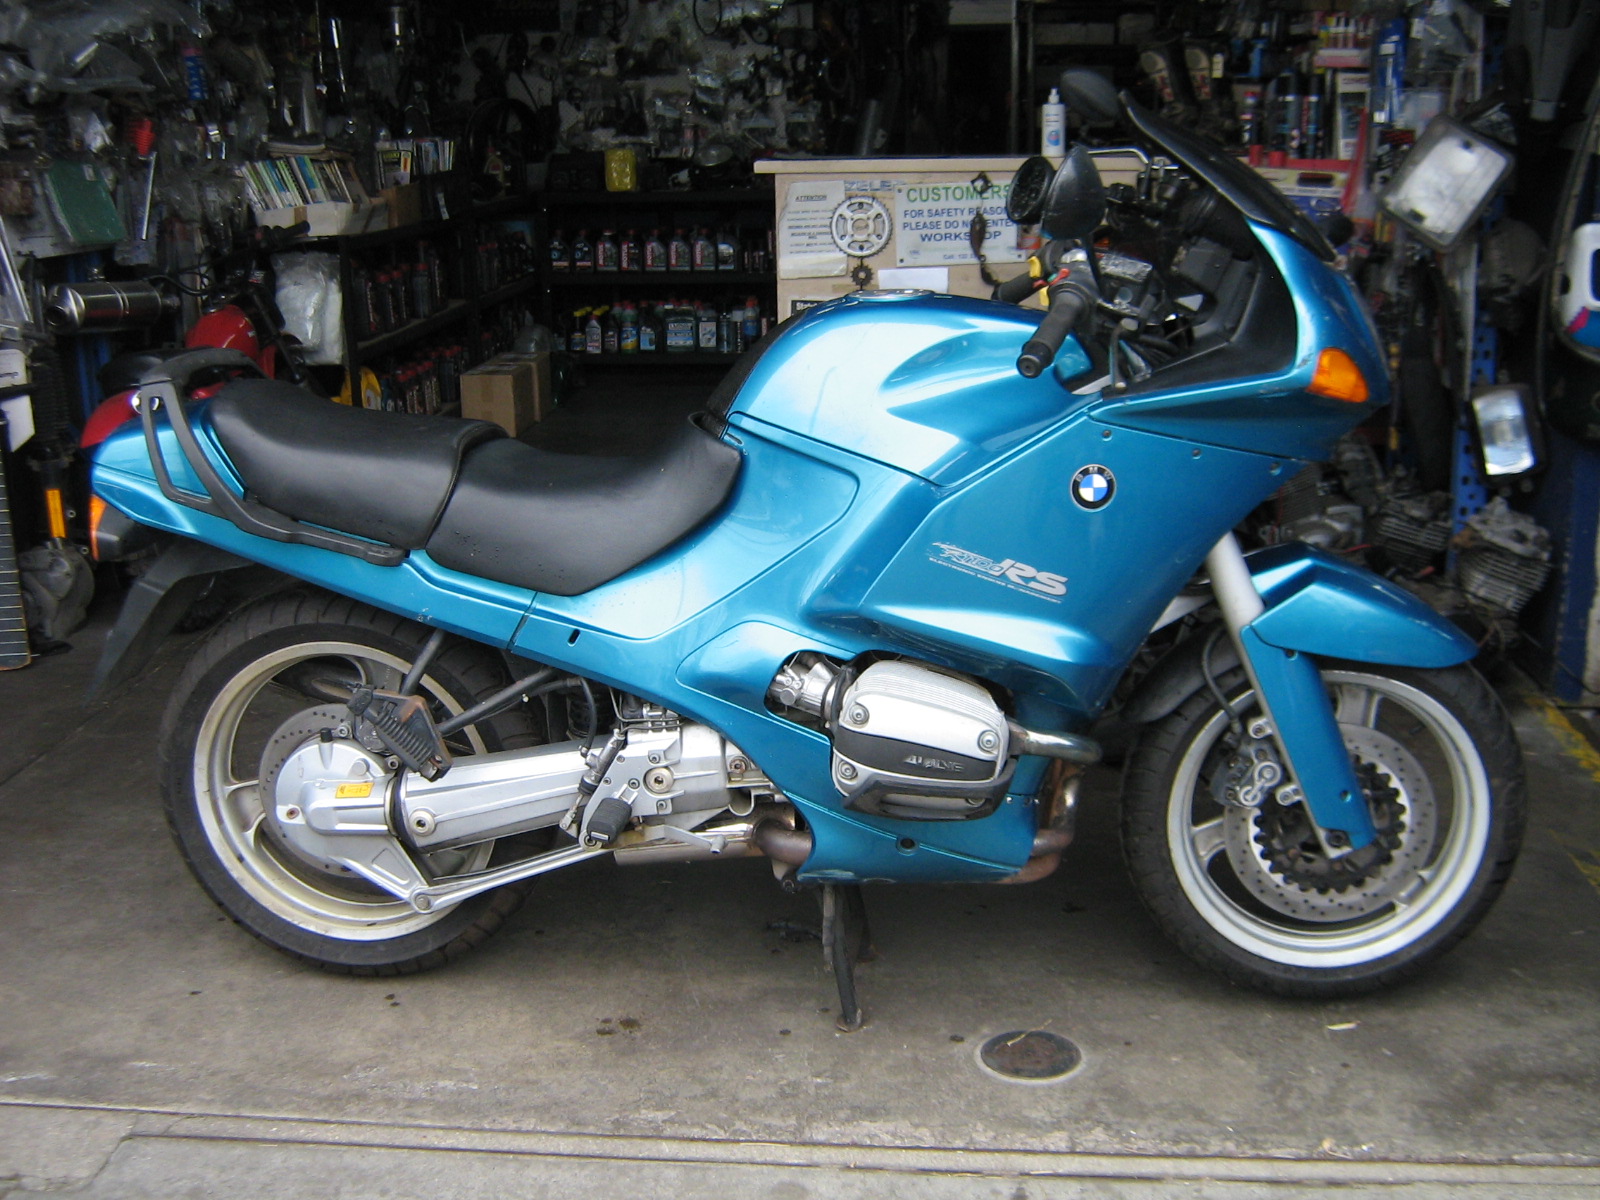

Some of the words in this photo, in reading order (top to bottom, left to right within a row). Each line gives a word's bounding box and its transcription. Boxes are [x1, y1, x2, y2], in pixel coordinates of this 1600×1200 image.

[907, 184, 1011, 203] CUSTOMERS
[904, 209, 925, 219] FOR
[927, 207, 966, 218] SAFETY
[903, 220, 942, 231] PLEASE
[945, 219, 959, 230] DO
[920, 231, 1002, 242] WORKSOP
[1075, 466, 1113, 482] BMW
